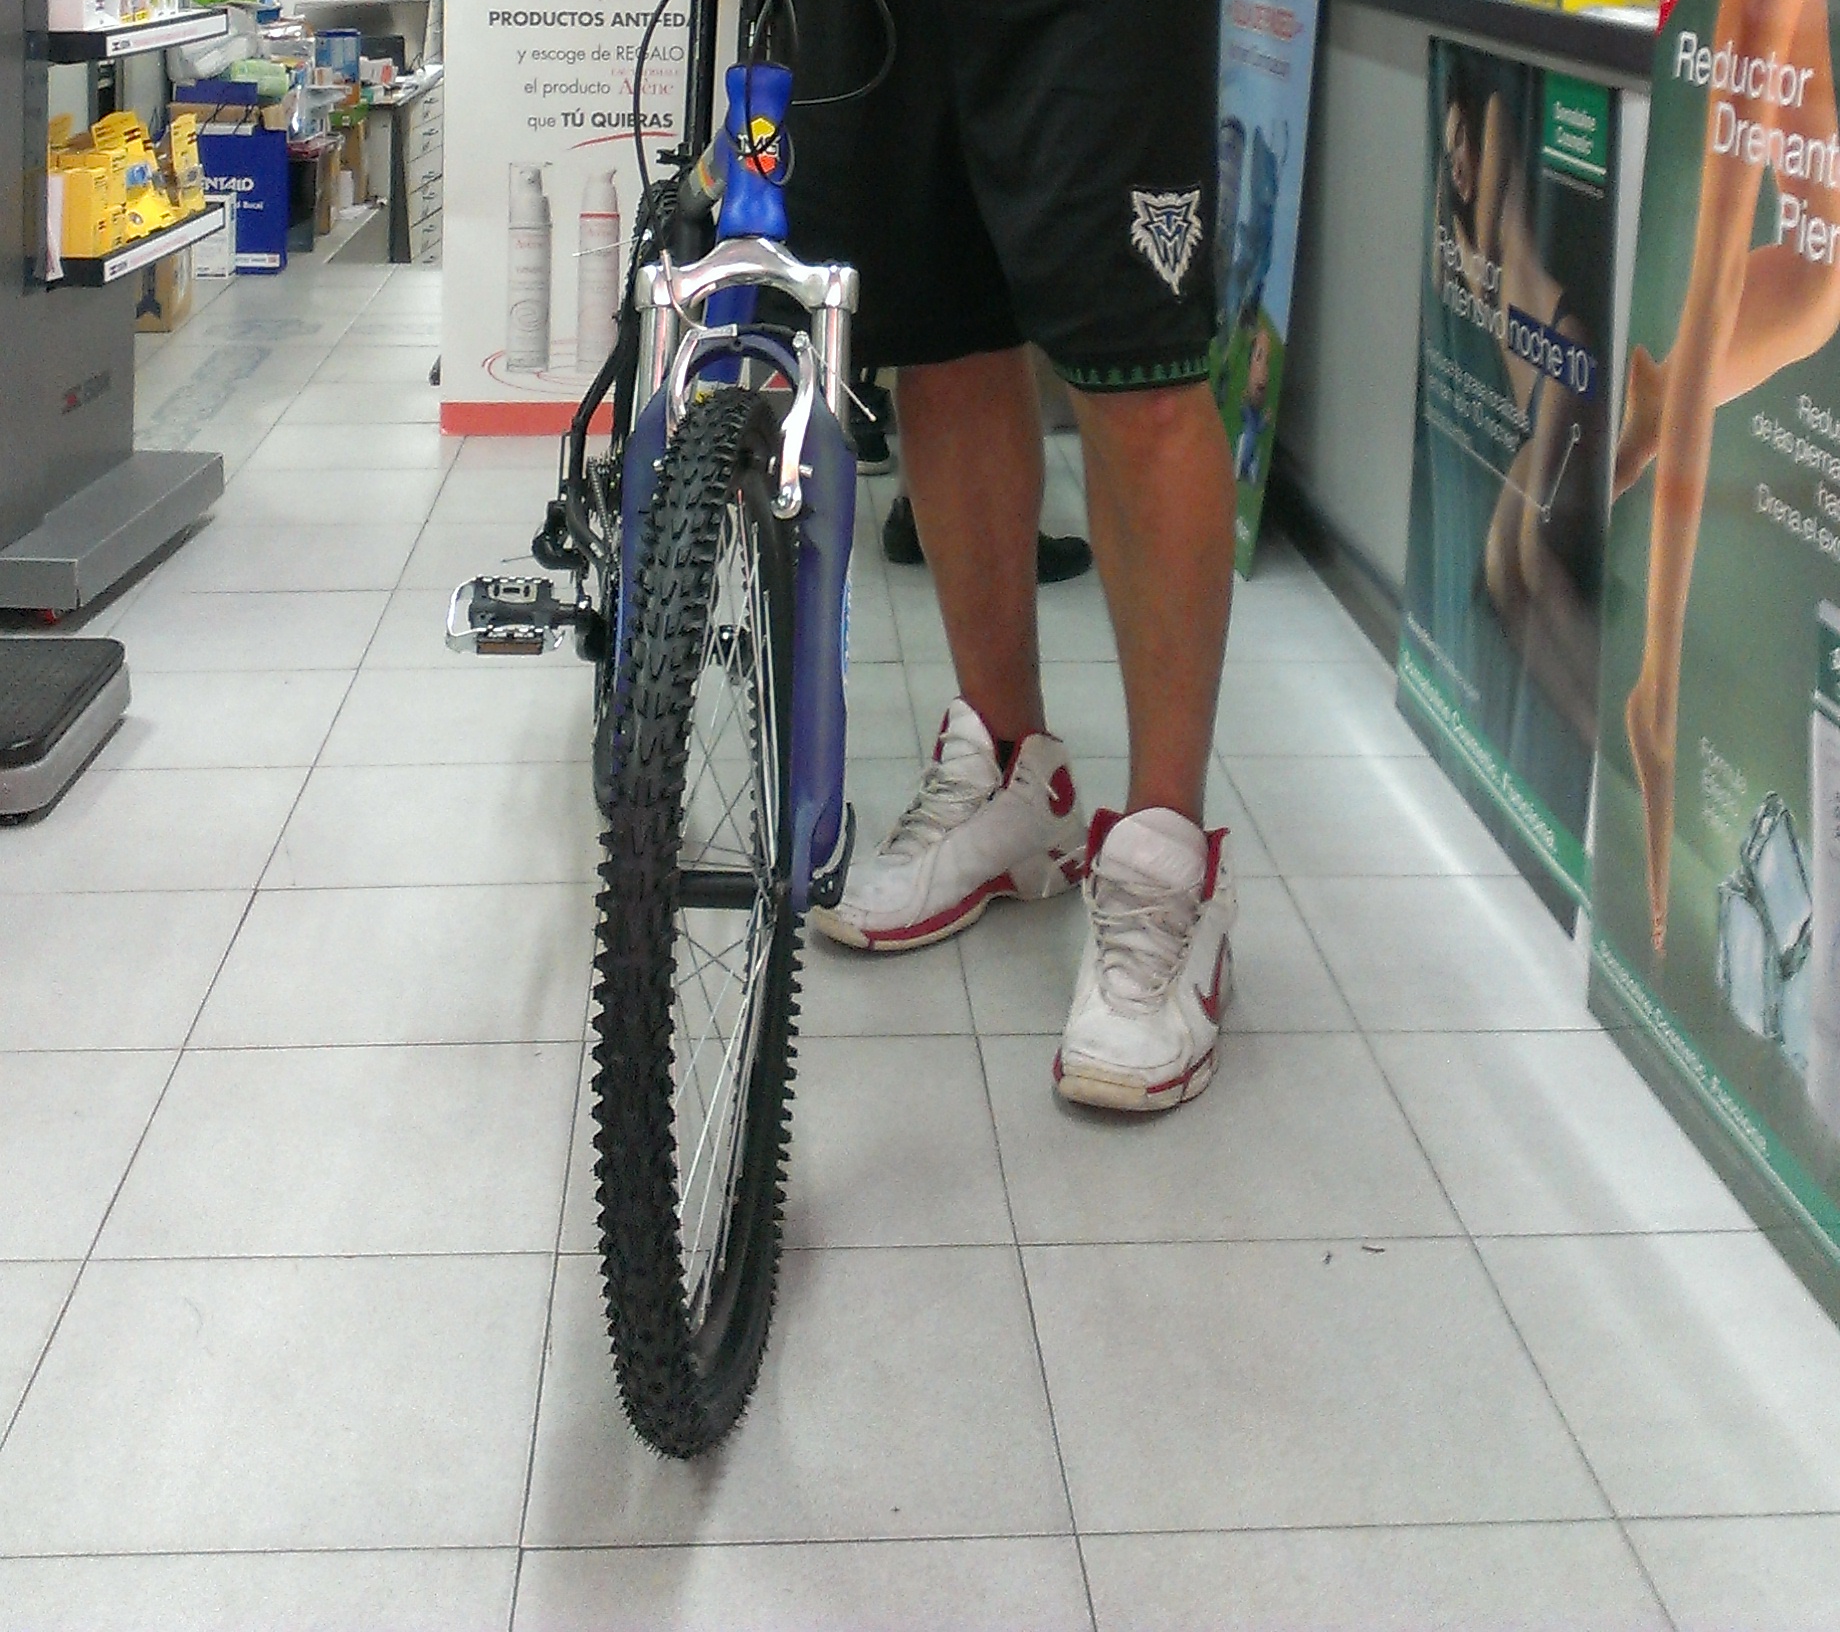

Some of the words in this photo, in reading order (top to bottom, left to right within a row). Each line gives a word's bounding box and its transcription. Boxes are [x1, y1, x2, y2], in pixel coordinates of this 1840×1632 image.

[489, 11, 604, 28] PRODUCTOS
[611, 11, 690, 27] ANT-ED
[517, 49, 527, 64] y
[531, 49, 586, 64] escoge
[591, 45, 611, 61] de
[616, 46, 684, 61] REGALO
[1674, 31, 1815, 107] Reductor
[524, 79, 537, 94] el
[543, 79, 611, 97] producto
[619, 77, 674, 95] Aène
[528, 117, 556, 131] que
[561, 108, 586, 128] TÚ
[591, 113, 674, 129] QUIERAS
[1439, 225, 1502, 294] Redor
[1509, 319, 1564, 379] noche
[1566, 345, 1590, 393] 10
